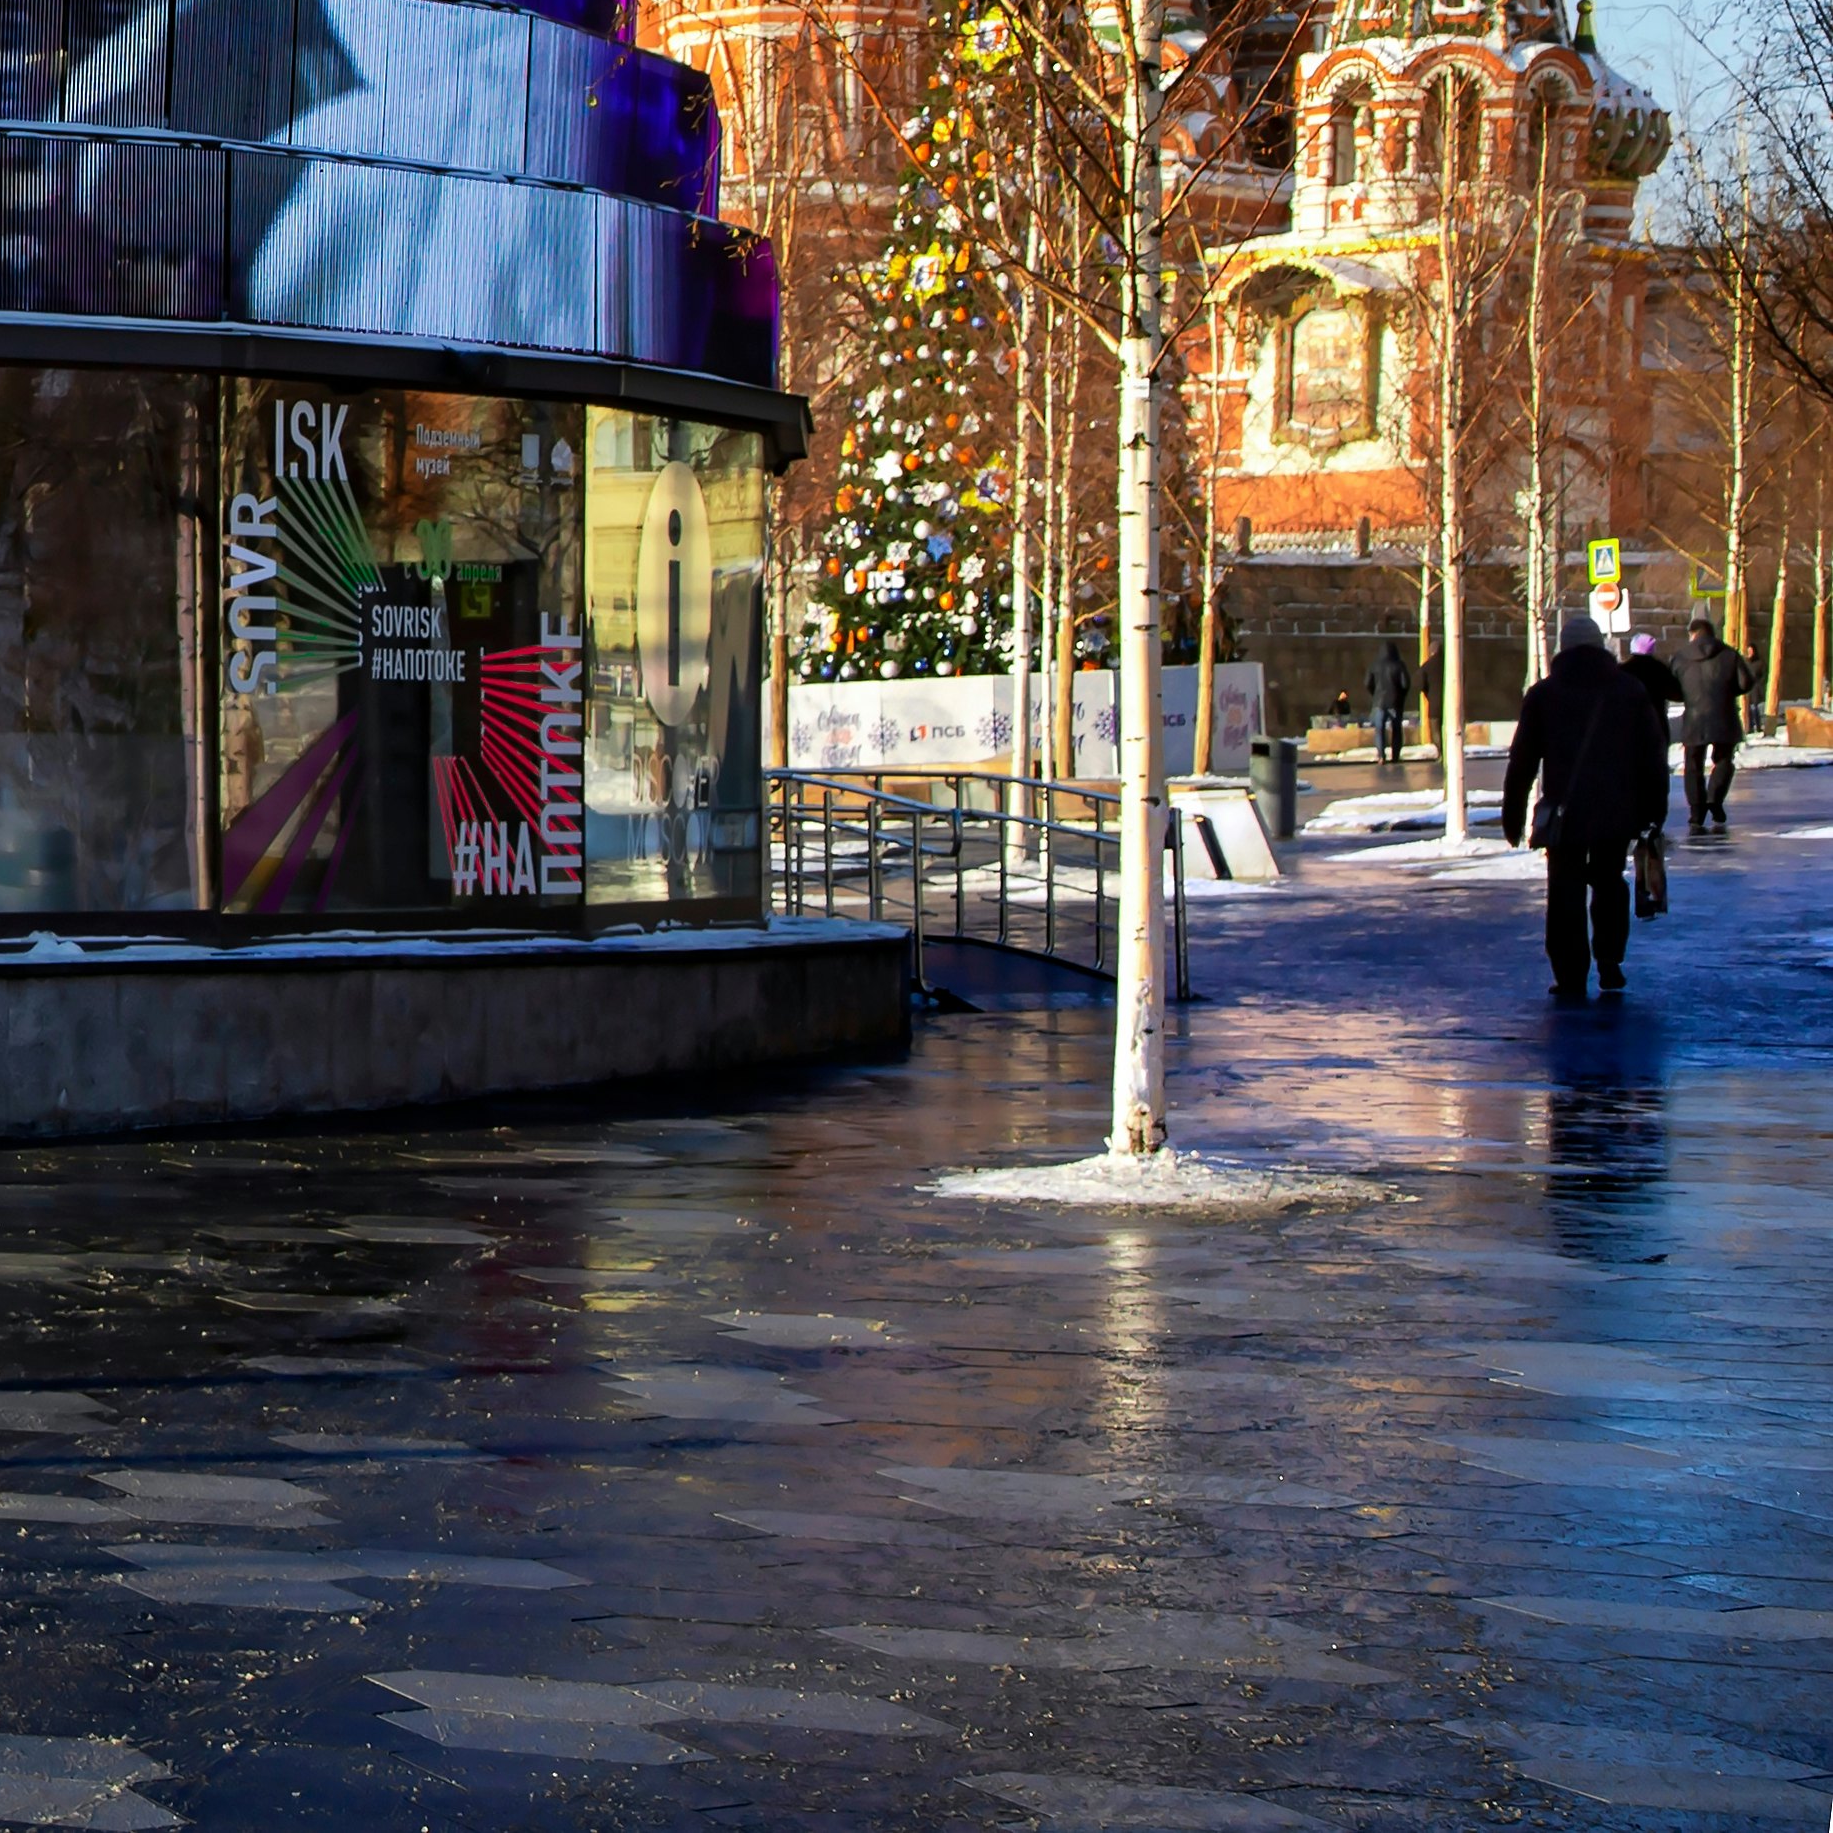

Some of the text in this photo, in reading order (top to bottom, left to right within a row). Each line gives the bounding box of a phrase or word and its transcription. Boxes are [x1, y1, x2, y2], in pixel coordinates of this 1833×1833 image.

[416, 423, 481, 450] Подземный
[416, 455, 451, 480] музей
[456, 562, 503, 588] апреля
[372, 604, 442, 639] SOVRISK
[372, 647, 466, 682] #НАПОТОКЕ
[931, 725, 966, 739] ПСБ
[452, 821, 537, 896] #НА
